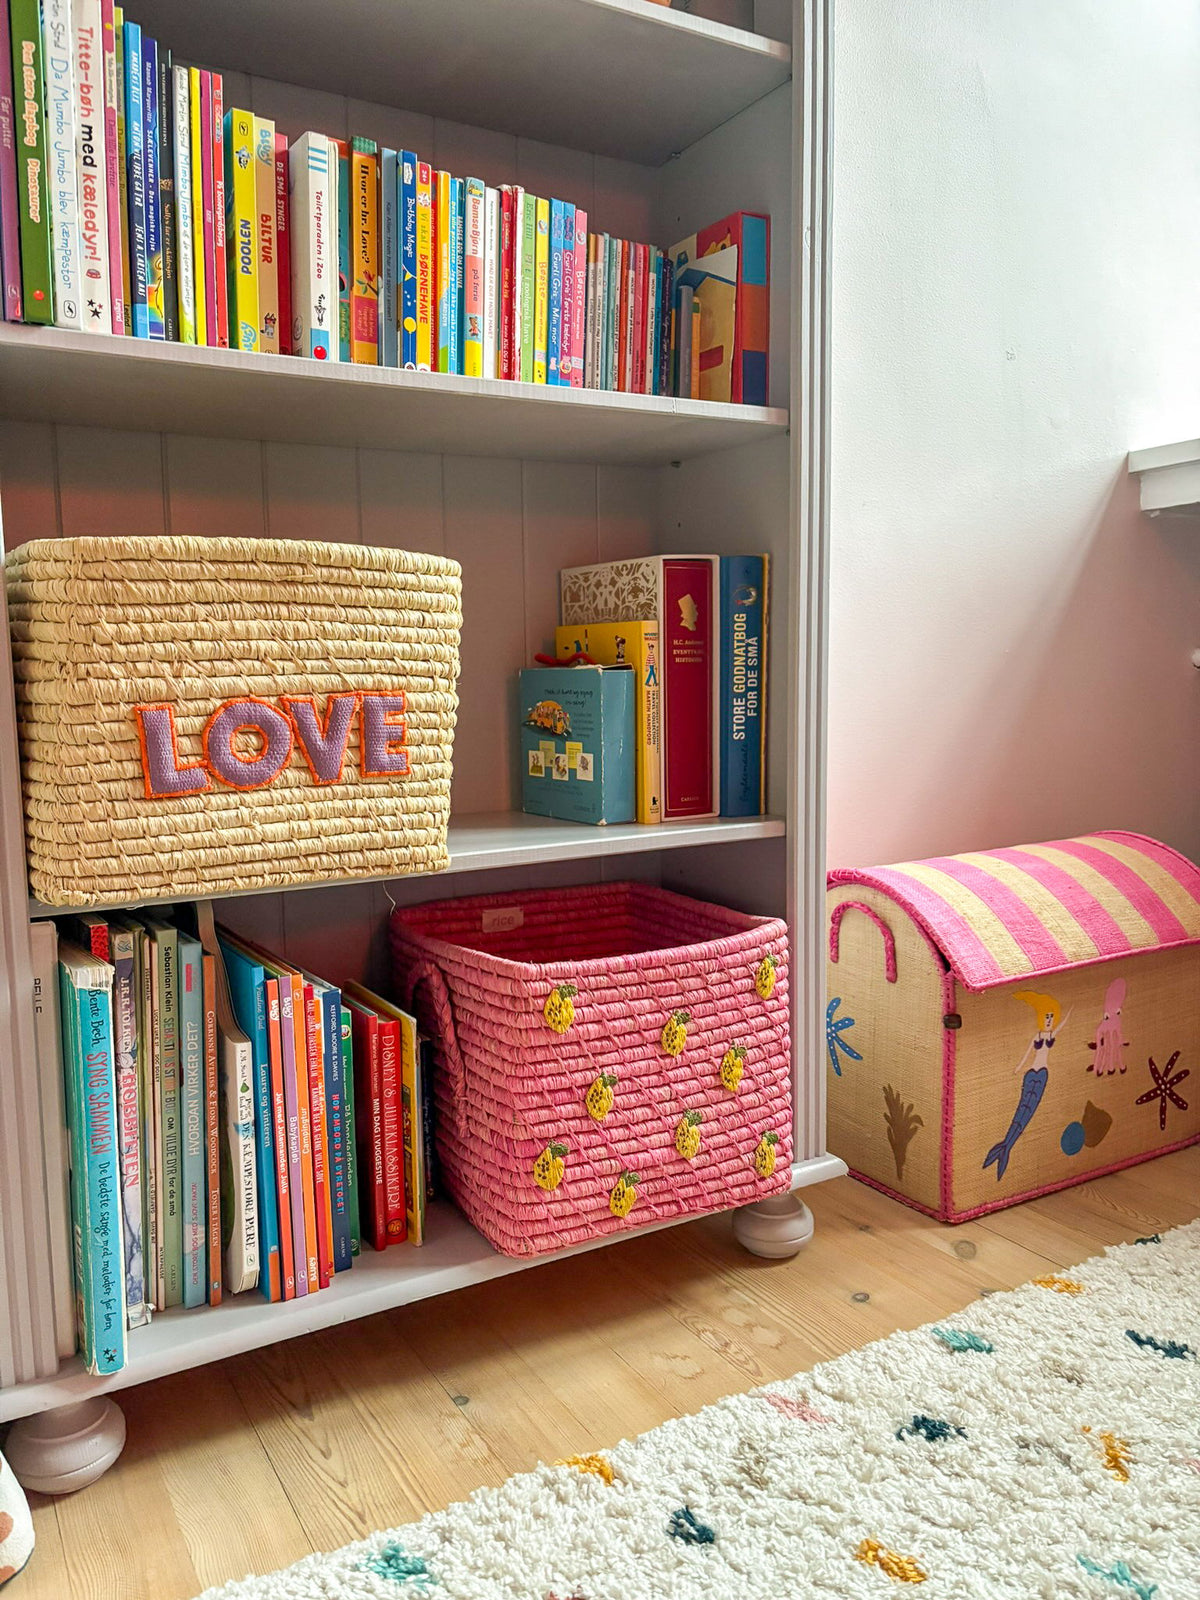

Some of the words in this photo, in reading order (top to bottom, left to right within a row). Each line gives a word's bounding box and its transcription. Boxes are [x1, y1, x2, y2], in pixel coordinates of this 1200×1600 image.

[23, 41, 36, 65] Den
[24, 66, 38, 98] store
[51, 57, 69, 79] Da
[78, 27, 95, 117] Titte-bøh
[1, 96, 12, 113] Far
[54, 85, 71, 135] Mumbo
[178, 94, 188, 121] Martin
[1, 117, 14, 148] putter
[24, 101, 40, 147] flapbog
[132, 121, 142, 148] ANTON
[81, 123, 98, 167] med
[55, 141, 72, 183] Jumbo
[134, 161, 142, 183] IKKE
[180, 153, 190, 189] Mimbo
[276, 162, 284, 172] DE
[28, 158, 41, 223] Dinosaurer
[277, 177, 287, 196] SMÅ
[359, 164, 370, 192] Hvor
[58, 191, 73, 215] blev
[180, 191, 191, 227] Jimbo
[277, 200, 285, 232] SYNGER
[360, 196, 369, 208] er
[405, 197, 416, 231] Birthday
[526, 203, 534, 221] Eric
[82, 173, 102, 261] kæledyr!
[147, 203, 157, 233] magiske
[313, 190, 324, 255] Toiletparaden
[360, 210, 370, 226] hr.
[420, 213, 428, 221] Vi
[260, 213, 273, 264] BILTUR
[420, 224, 429, 242] skal
[526, 224, 534, 240] Hill
[58, 222, 75, 289] kæmpestor
[240, 219, 253, 275] POOLEN
[361, 230, 371, 263] Love?
[136, 252, 146, 280] LARSEN
[316, 263, 324, 279] Zoo
[472, 269, 480, 279] på
[553, 252, 561, 276] Gurli
[564, 252, 574, 274] Gurli
[419, 253, 429, 324] BØRNEHAVE
[472, 282, 480, 302] ferie
[552, 278, 561, 297] Gris
[114, 298, 123, 322] Legind
[522, 283, 531, 321] zoologisk
[552, 308, 560, 324] Min
[564, 298, 574, 321] første
[562, 323, 572, 353] kæledyr
[733, 613, 747, 693] GODNATBOG
[745, 637, 759, 666] SMÅ
[747, 671, 758, 687] DE
[747, 692, 758, 717] FOR
[733, 698, 746, 740] STORE
[134, 690, 411, 798] LOVE
[163, 946, 174, 989] Sebastian
[87, 989, 103, 1017] Bente
[119, 976, 130, 1008] J.R.R.
[164, 991, 174, 1012] Klein
[255, 986, 264, 1013] Pauline
[91, 1020, 107, 1048] Bech
[122, 1009, 133, 1052] TOLKIEN
[187, 1021, 199, 1050] DET?
[206, 1010, 215, 1054] CORRINNE
[86, 1050, 109, 1088] SYNG
[187, 1054, 199, 1094] VIRKER
[207, 1055, 216, 1089] AVERISS
[259, 1063, 268, 1093] Laura
[382, 1034, 398, 1098] DISNEY'S
[259, 1095, 268, 1107] og
[275, 1092, 283, 1103] Jul
[332, 1094, 340, 1110] HOP
[372, 1098, 381, 1115] MIN
[88, 1091, 113, 1156] SAMMEN
[167, 1117, 175, 1130] OM
[209, 1100, 218, 1126] FIONA
[373, 1116, 382, 1132] DAG
[187, 1099, 201, 1157] HVORDAN
[241, 1122, 251, 1140] DEN
[262, 1109, 271, 1146] vinteren
[288, 1116, 299, 1163] Babykapløb
[333, 1112, 342, 1149] OMBORD
[166, 1132, 177, 1157] VILDE
[209, 1126, 219, 1174] WOODCOCK
[277, 1125, 287, 1173] Julemanden
[334, 1152, 344, 1162] PÅ
[385, 1103, 401, 1211] JULEKLASSIKERE
[99, 1161, 112, 1175] De
[166, 1159, 178, 1175] DYR
[374, 1138, 384, 1185] VUGGESTUE
[168, 1176, 177, 1188] for
[242, 1142, 254, 1216] KÆMPESTORE
[280, 1174, 289, 1194] Julle
[335, 1164, 345, 1215] DYRETOGET!
[98, 1178, 113, 1209] bedste
[168, 1190, 177, 1199] de
[169, 1201, 178, 1216] små
[94, 1212, 113, 1237] sange
[244, 1216, 256, 1251] PÆRE
[102, 1240, 114, 1258] med
[101, 1260, 116, 1295] melodier
[101, 1298, 117, 1311] for
[103, 1312, 118, 1332] børn
